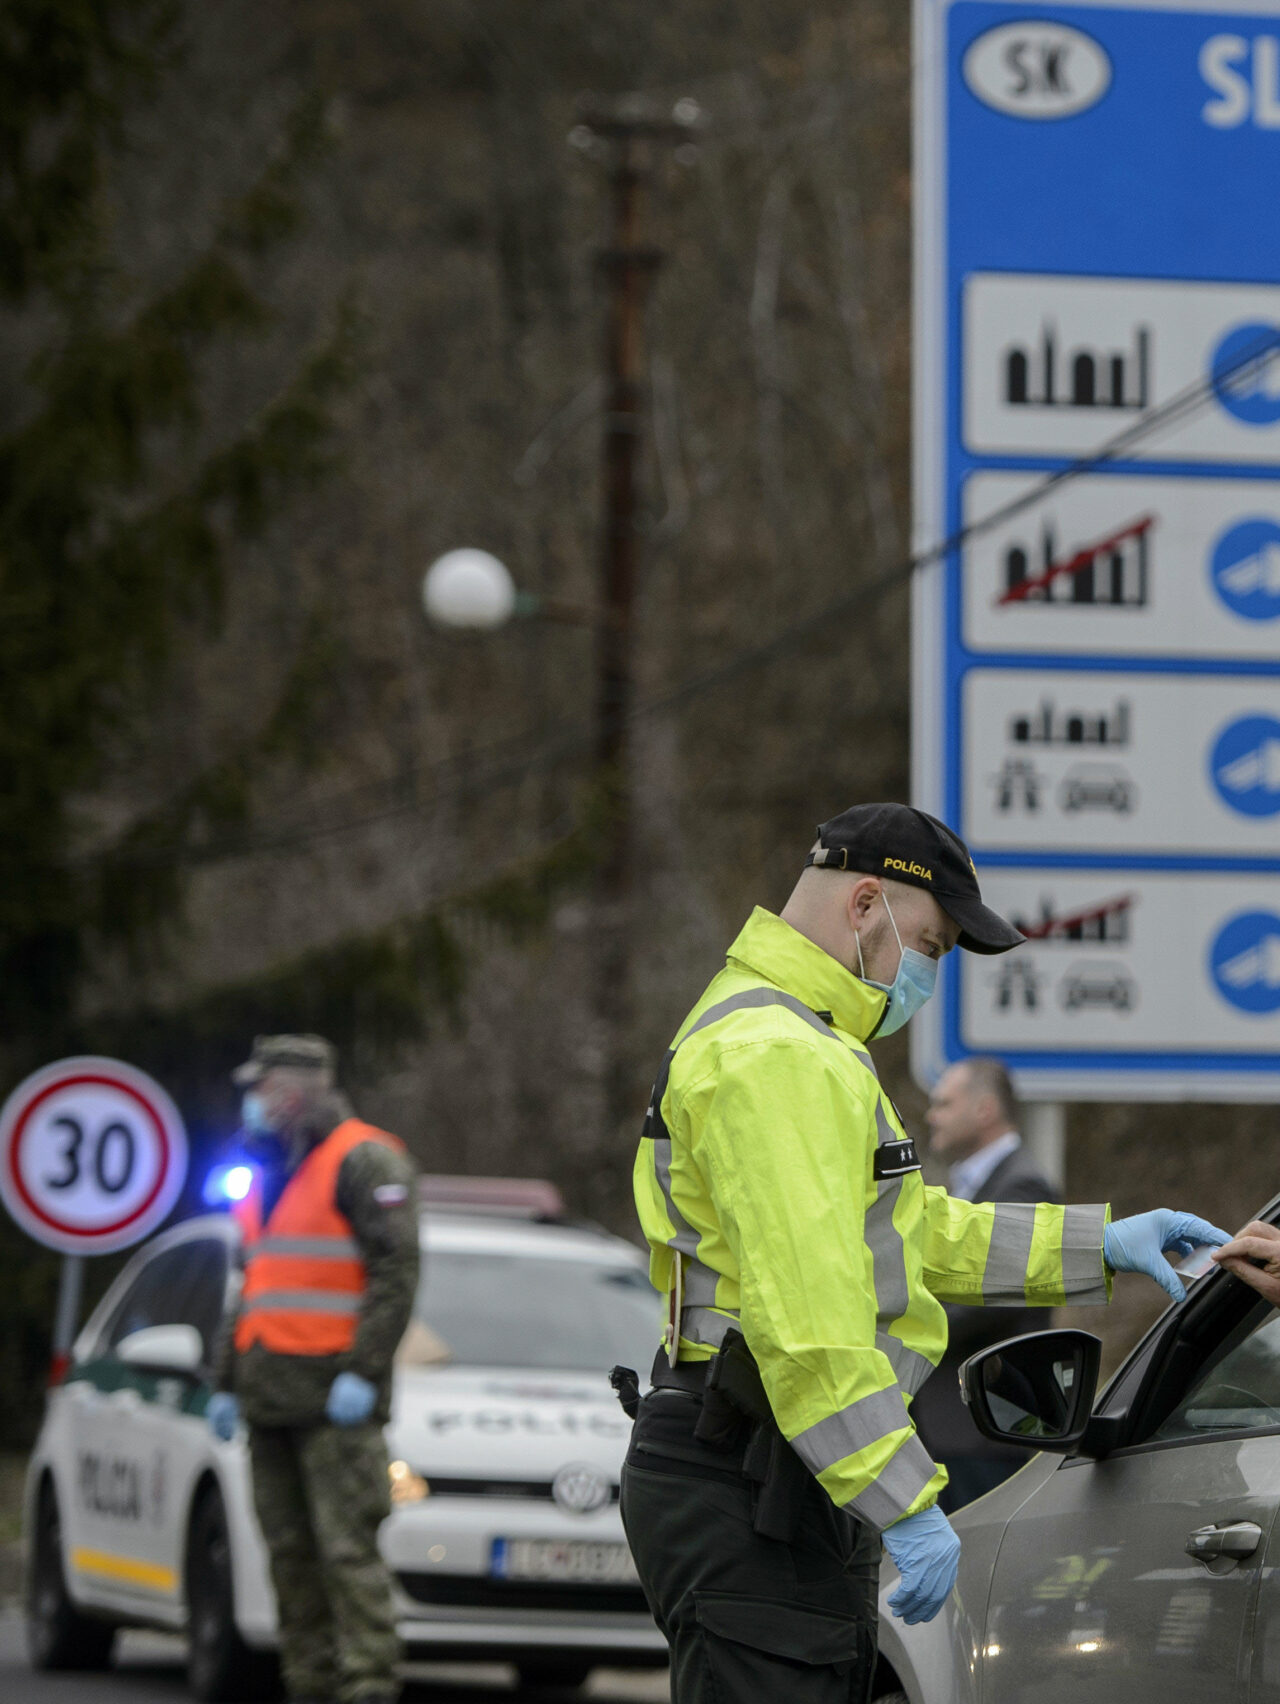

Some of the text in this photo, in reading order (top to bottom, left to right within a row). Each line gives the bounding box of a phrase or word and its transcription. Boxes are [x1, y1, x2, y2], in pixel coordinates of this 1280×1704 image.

[1005, 39, 1072, 97] SK
[884, 857, 933, 881] POLÍCIA
[44, 1116, 137, 1194] 30
